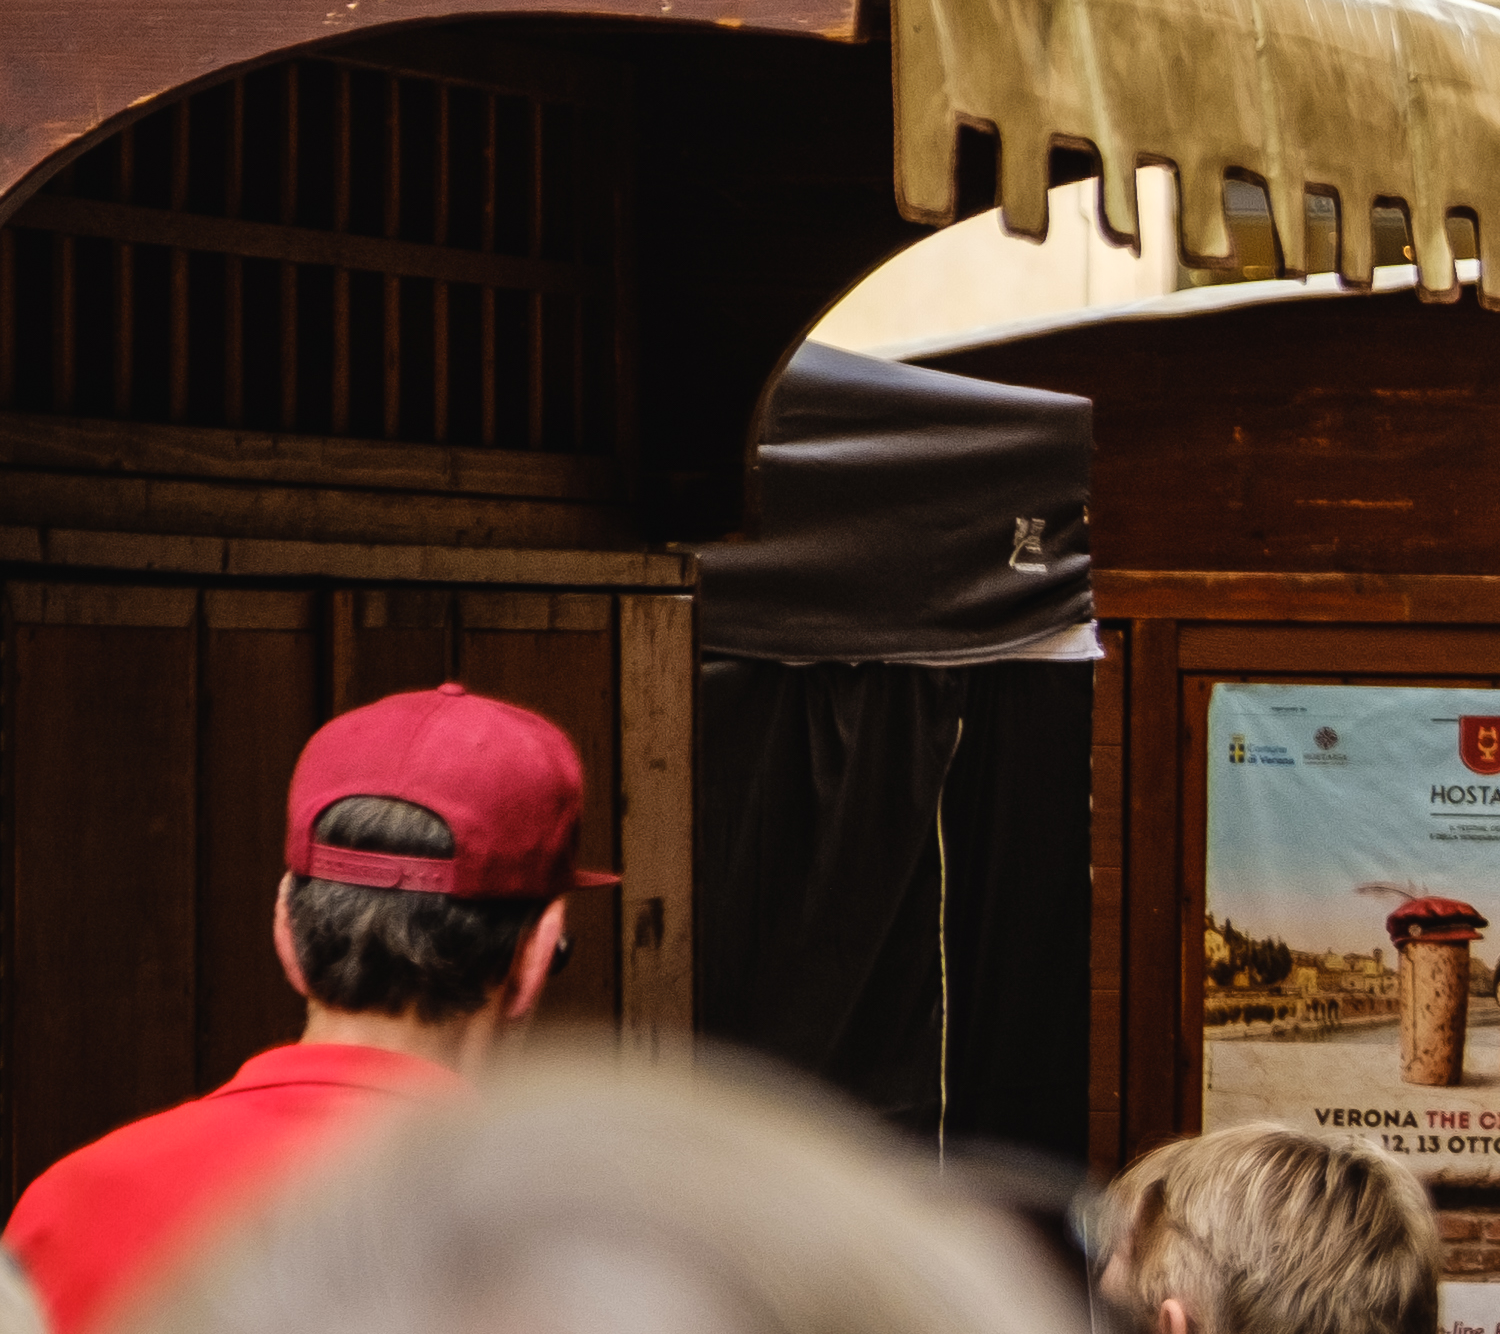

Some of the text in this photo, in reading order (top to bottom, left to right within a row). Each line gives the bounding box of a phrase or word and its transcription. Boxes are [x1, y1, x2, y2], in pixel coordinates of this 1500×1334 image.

[1314, 1108, 1418, 1127] VERONA
[1426, 1110, 1470, 1129] THE
[1417, 1135, 1440, 1153] 13
